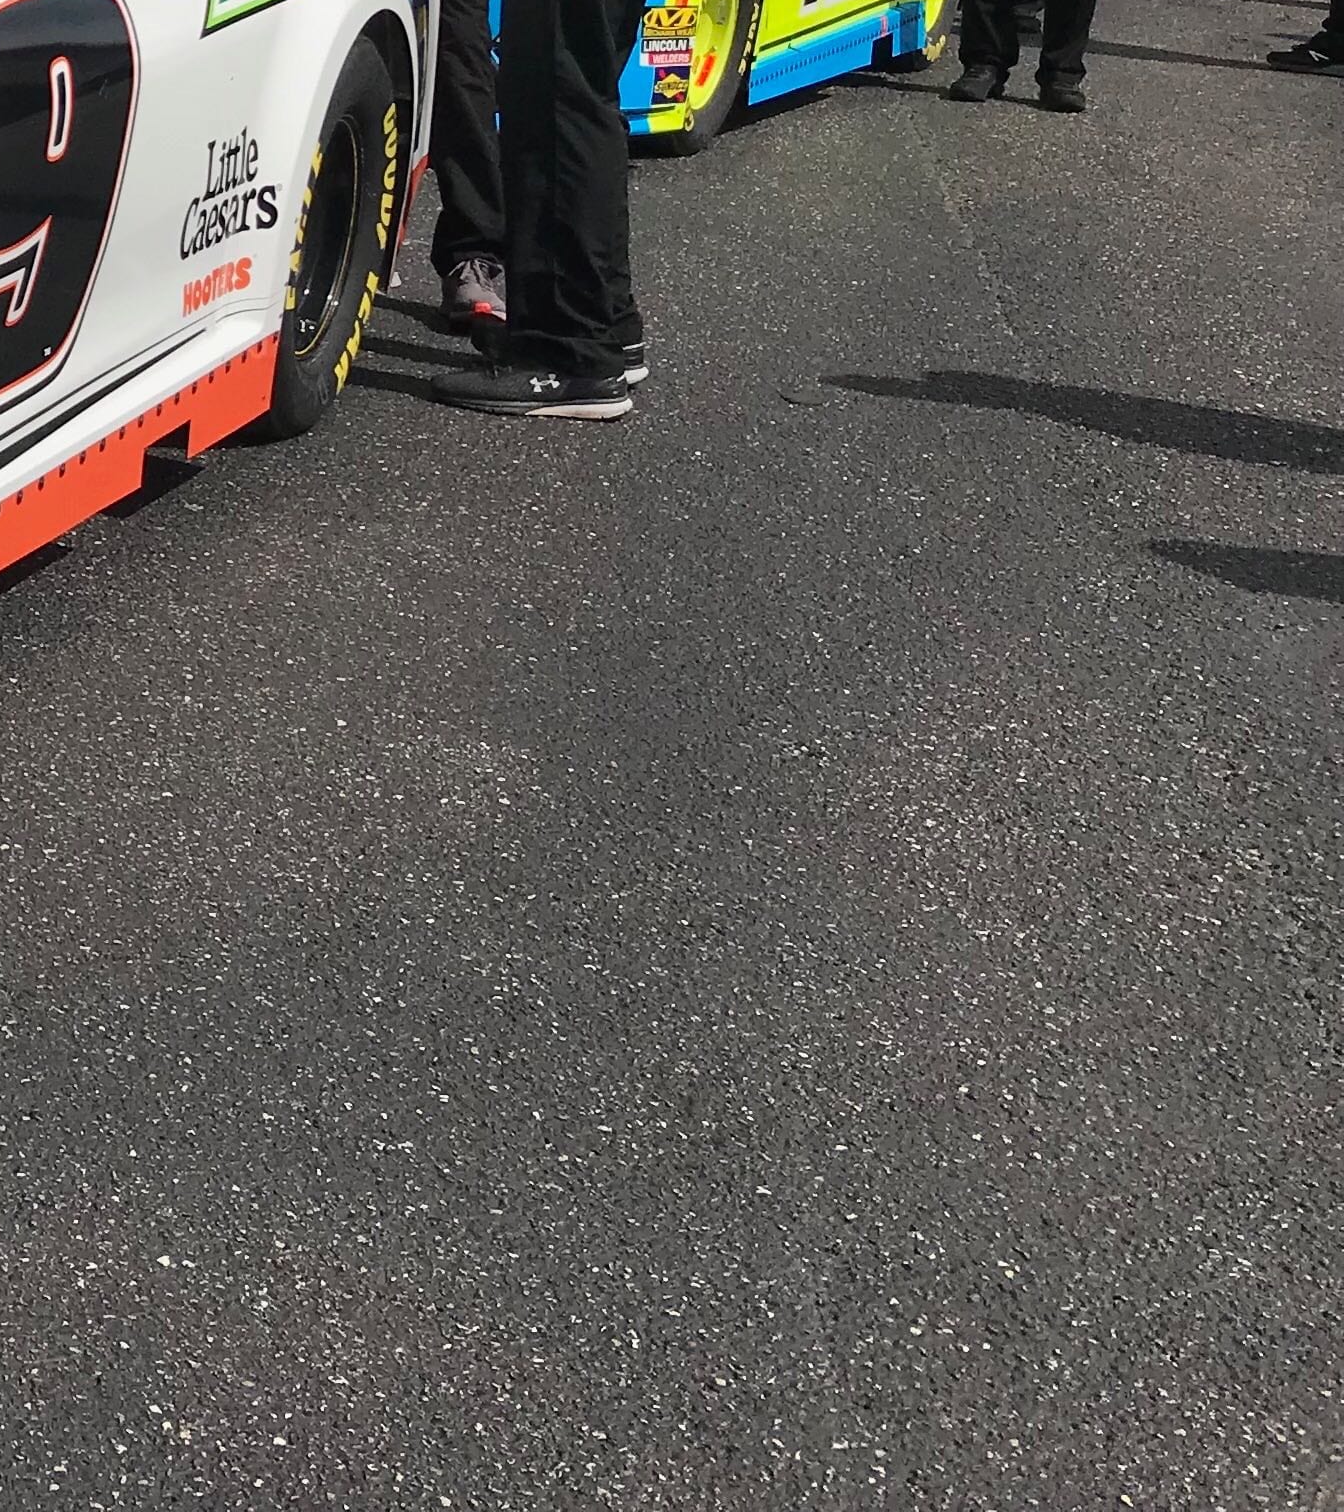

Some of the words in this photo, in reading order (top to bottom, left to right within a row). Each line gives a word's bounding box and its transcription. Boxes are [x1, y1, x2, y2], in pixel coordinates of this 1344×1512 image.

[643, 39, 688, 53] LINCOLN
[652, 53, 690, 64] WELDERS
[201, 125, 259, 204] Little
[179, 183, 279, 261] Caesars
[182, 257, 252, 317] HOOTERS
